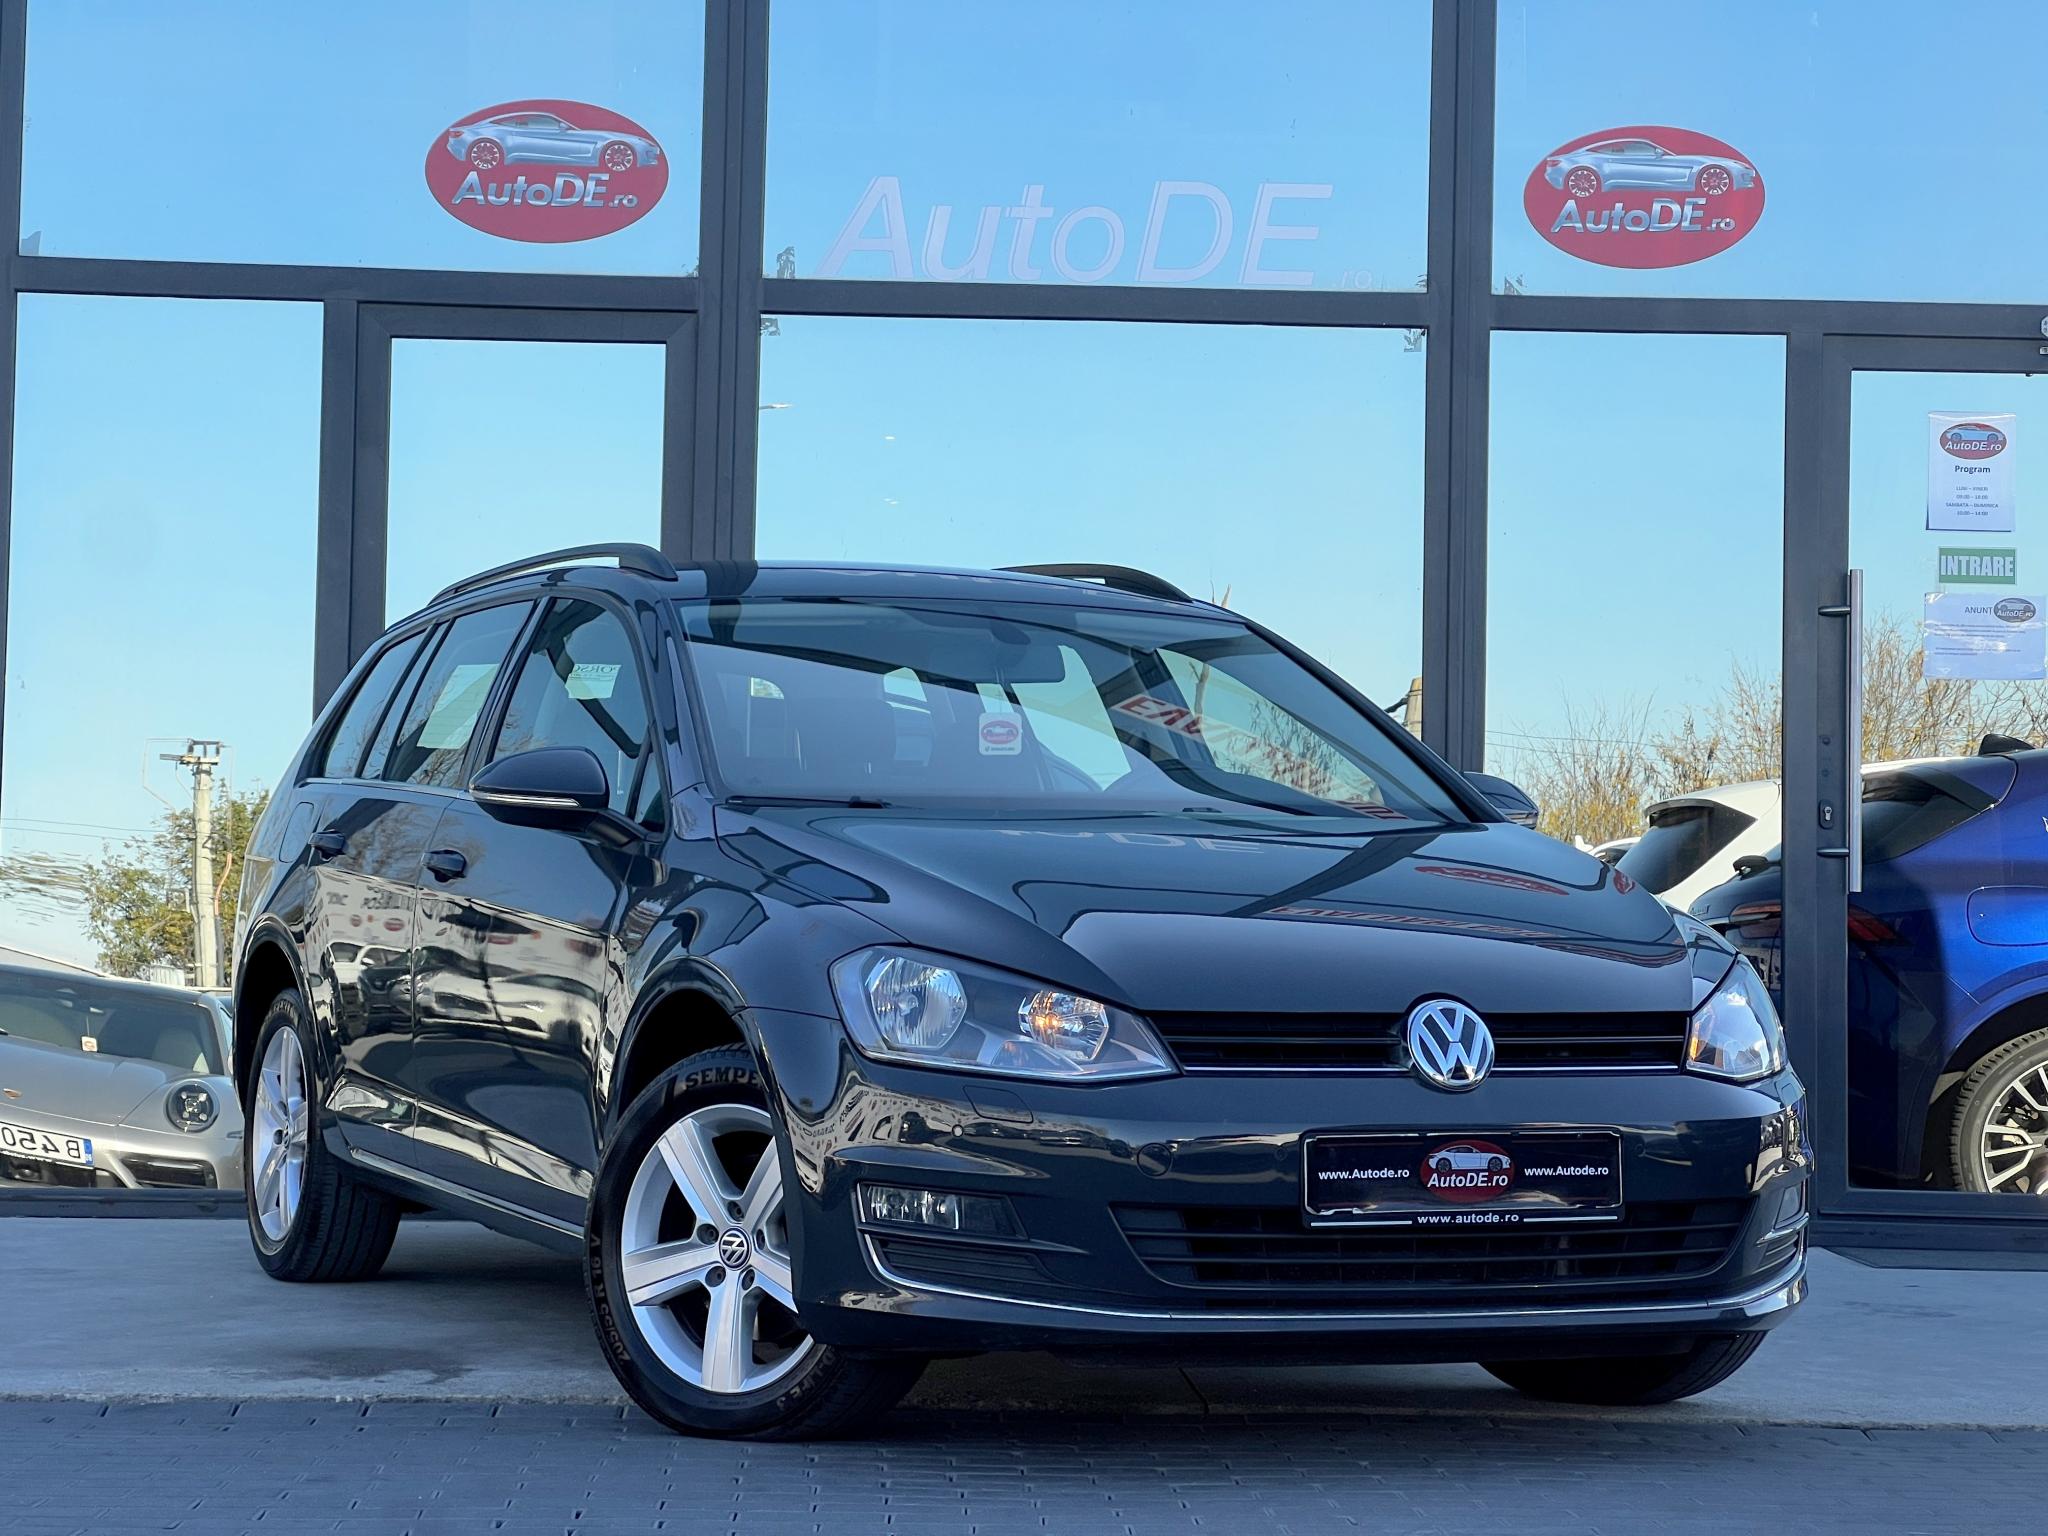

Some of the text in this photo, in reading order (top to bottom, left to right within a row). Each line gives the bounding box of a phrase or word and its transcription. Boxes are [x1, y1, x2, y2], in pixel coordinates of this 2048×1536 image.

[1944, 441, 2002, 451] AutoDE.ro
[1954, 465, 1991, 475] Program
[1941, 555, 2014, 577] INTRARE
[684, 1066, 763, 1089] SEMPE
[1318, 1167, 1410, 1180] www.Autode.ro
[1524, 1165, 1609, 1176] www.Autode.ro
[1427, 1172, 1509, 1188] AutoDE.ro
[1417, 1212, 1519, 1224] www.autode.ro
